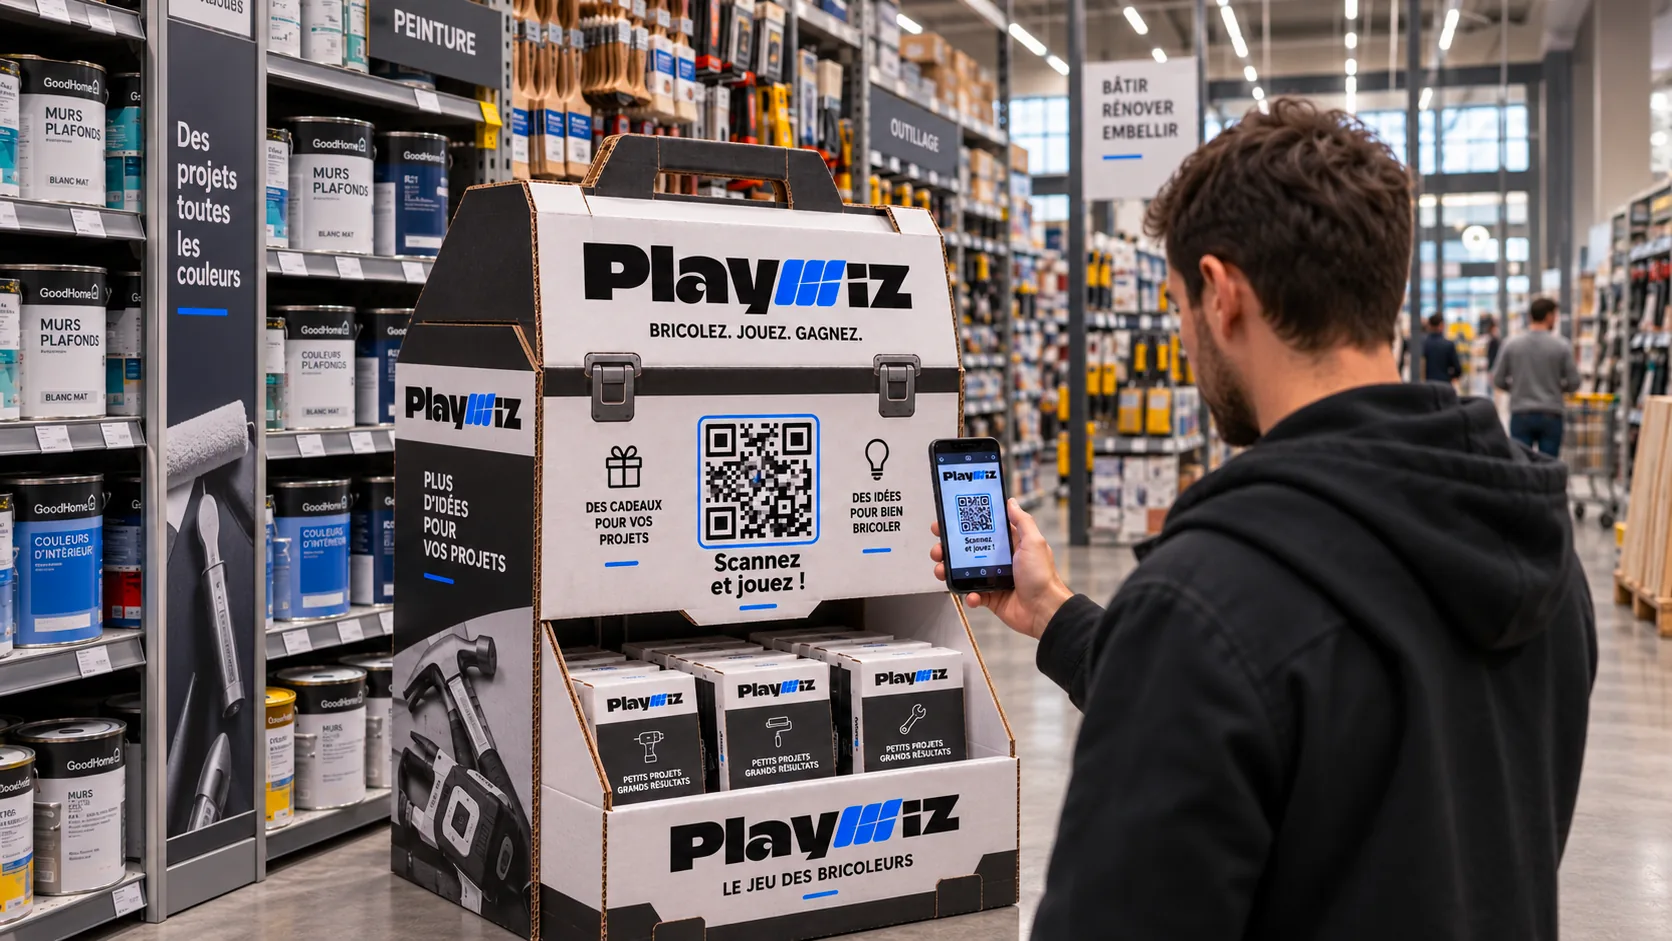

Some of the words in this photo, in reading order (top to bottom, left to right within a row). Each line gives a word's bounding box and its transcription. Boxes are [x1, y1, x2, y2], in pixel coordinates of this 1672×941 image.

[393, 9, 476, 56] PEINTURE
[44, 77, 92, 93] GoodHome
[1102, 76, 1148, 96] BÂTIR
[45, 107, 83, 122] MURS
[1102, 100, 1174, 118] RÉNOVER
[45, 123, 101, 141] PLAFONDS
[177, 121, 210, 151] Des
[890, 117, 940, 153] OUTILLAGE
[1102, 122, 1178, 141] EMBELLIR
[312, 138, 359, 151] GoodHome
[49, 176, 75, 185] BLANC
[177, 161, 237, 193] projets
[313, 167, 349, 180] MURS
[313, 182, 369, 197] PLAFONDS
[177, 195, 231, 224] toutes
[177, 230, 200, 258] les
[177, 261, 241, 288] couleurs
[40, 287, 91, 300] GoodHome
[40, 318, 81, 331] MURS
[649, 323, 732, 340] BRICOLEZ.
[736, 326, 791, 341] JOUEZ.
[796, 326, 863, 342] GAGNEZ.
[40, 334, 100, 347] PLAFONDS
[45, 393, 71, 402] BLANC
[71, 393, 88, 401] MAT
[424, 471, 453, 492] PLUS
[852, 492, 872, 503] DES
[874, 490, 902, 502] IDÉES
[34, 502, 88, 514] GoodHome
[424, 493, 469, 518] D'IDÉES
[586, 501, 608, 513] DES
[610, 499, 662, 512] CADEAUX
[850, 507, 878, 519] POUR
[880, 505, 903, 517] BIEN
[424, 516, 457, 539] POUR
[595, 517, 627, 529] POUR
[629, 515, 653, 528] VOS
[853, 521, 901, 534] BRICOLER
[34, 533, 89, 547] COULEURS
[599, 532, 649, 545] PROJETS
[423, 539, 447, 560] VOS
[451, 545, 506, 573] PROJETS
[714, 553, 801, 572] Scannez
[710, 578, 732, 595] et
[736, 575, 794, 599] jouez
[799, 572, 806, 590] !
[886, 743, 910, 752] PETITS
[912, 740, 944, 750] PROJETS
[67, 756, 115, 771] GoodHome
[752, 758, 777, 767] PETITS
[779, 753, 811, 763] PROJETS
[880, 752, 910, 763] GRANDS
[623, 774, 648, 783] PETITS
[649, 769, 682, 779] PROJETS
[745, 767, 777, 777] GRANDS
[68, 789, 94, 800] MURS
[618, 782, 649, 794] GRANDS
[723, 881, 742, 896] LE
[746, 873, 776, 892] JEU
[781, 869, 813, 886] DES
[817, 854, 914, 881] BRICOLEURS
